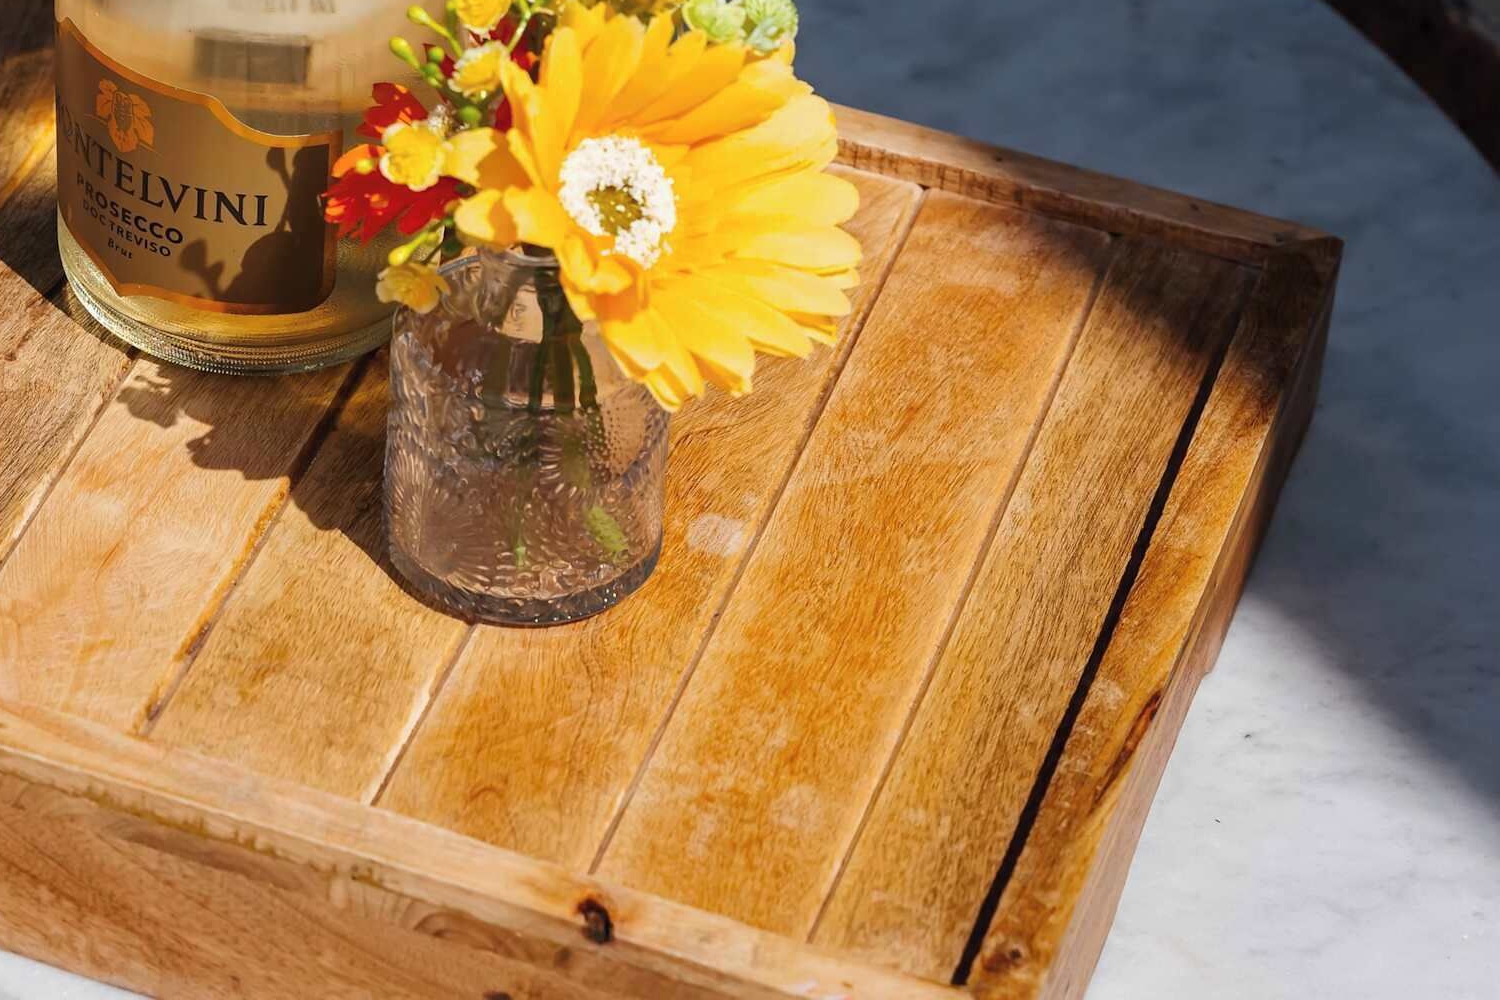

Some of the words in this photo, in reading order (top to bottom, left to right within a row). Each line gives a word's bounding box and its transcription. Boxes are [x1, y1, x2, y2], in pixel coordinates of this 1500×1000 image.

[60, 103, 268, 226] ONTELVINI
[77, 171, 184, 244] PROSECCO
[83, 199, 107, 226] DOC
[108, 219, 171, 257] TREVISO
[107, 237, 133, 259] Brut
